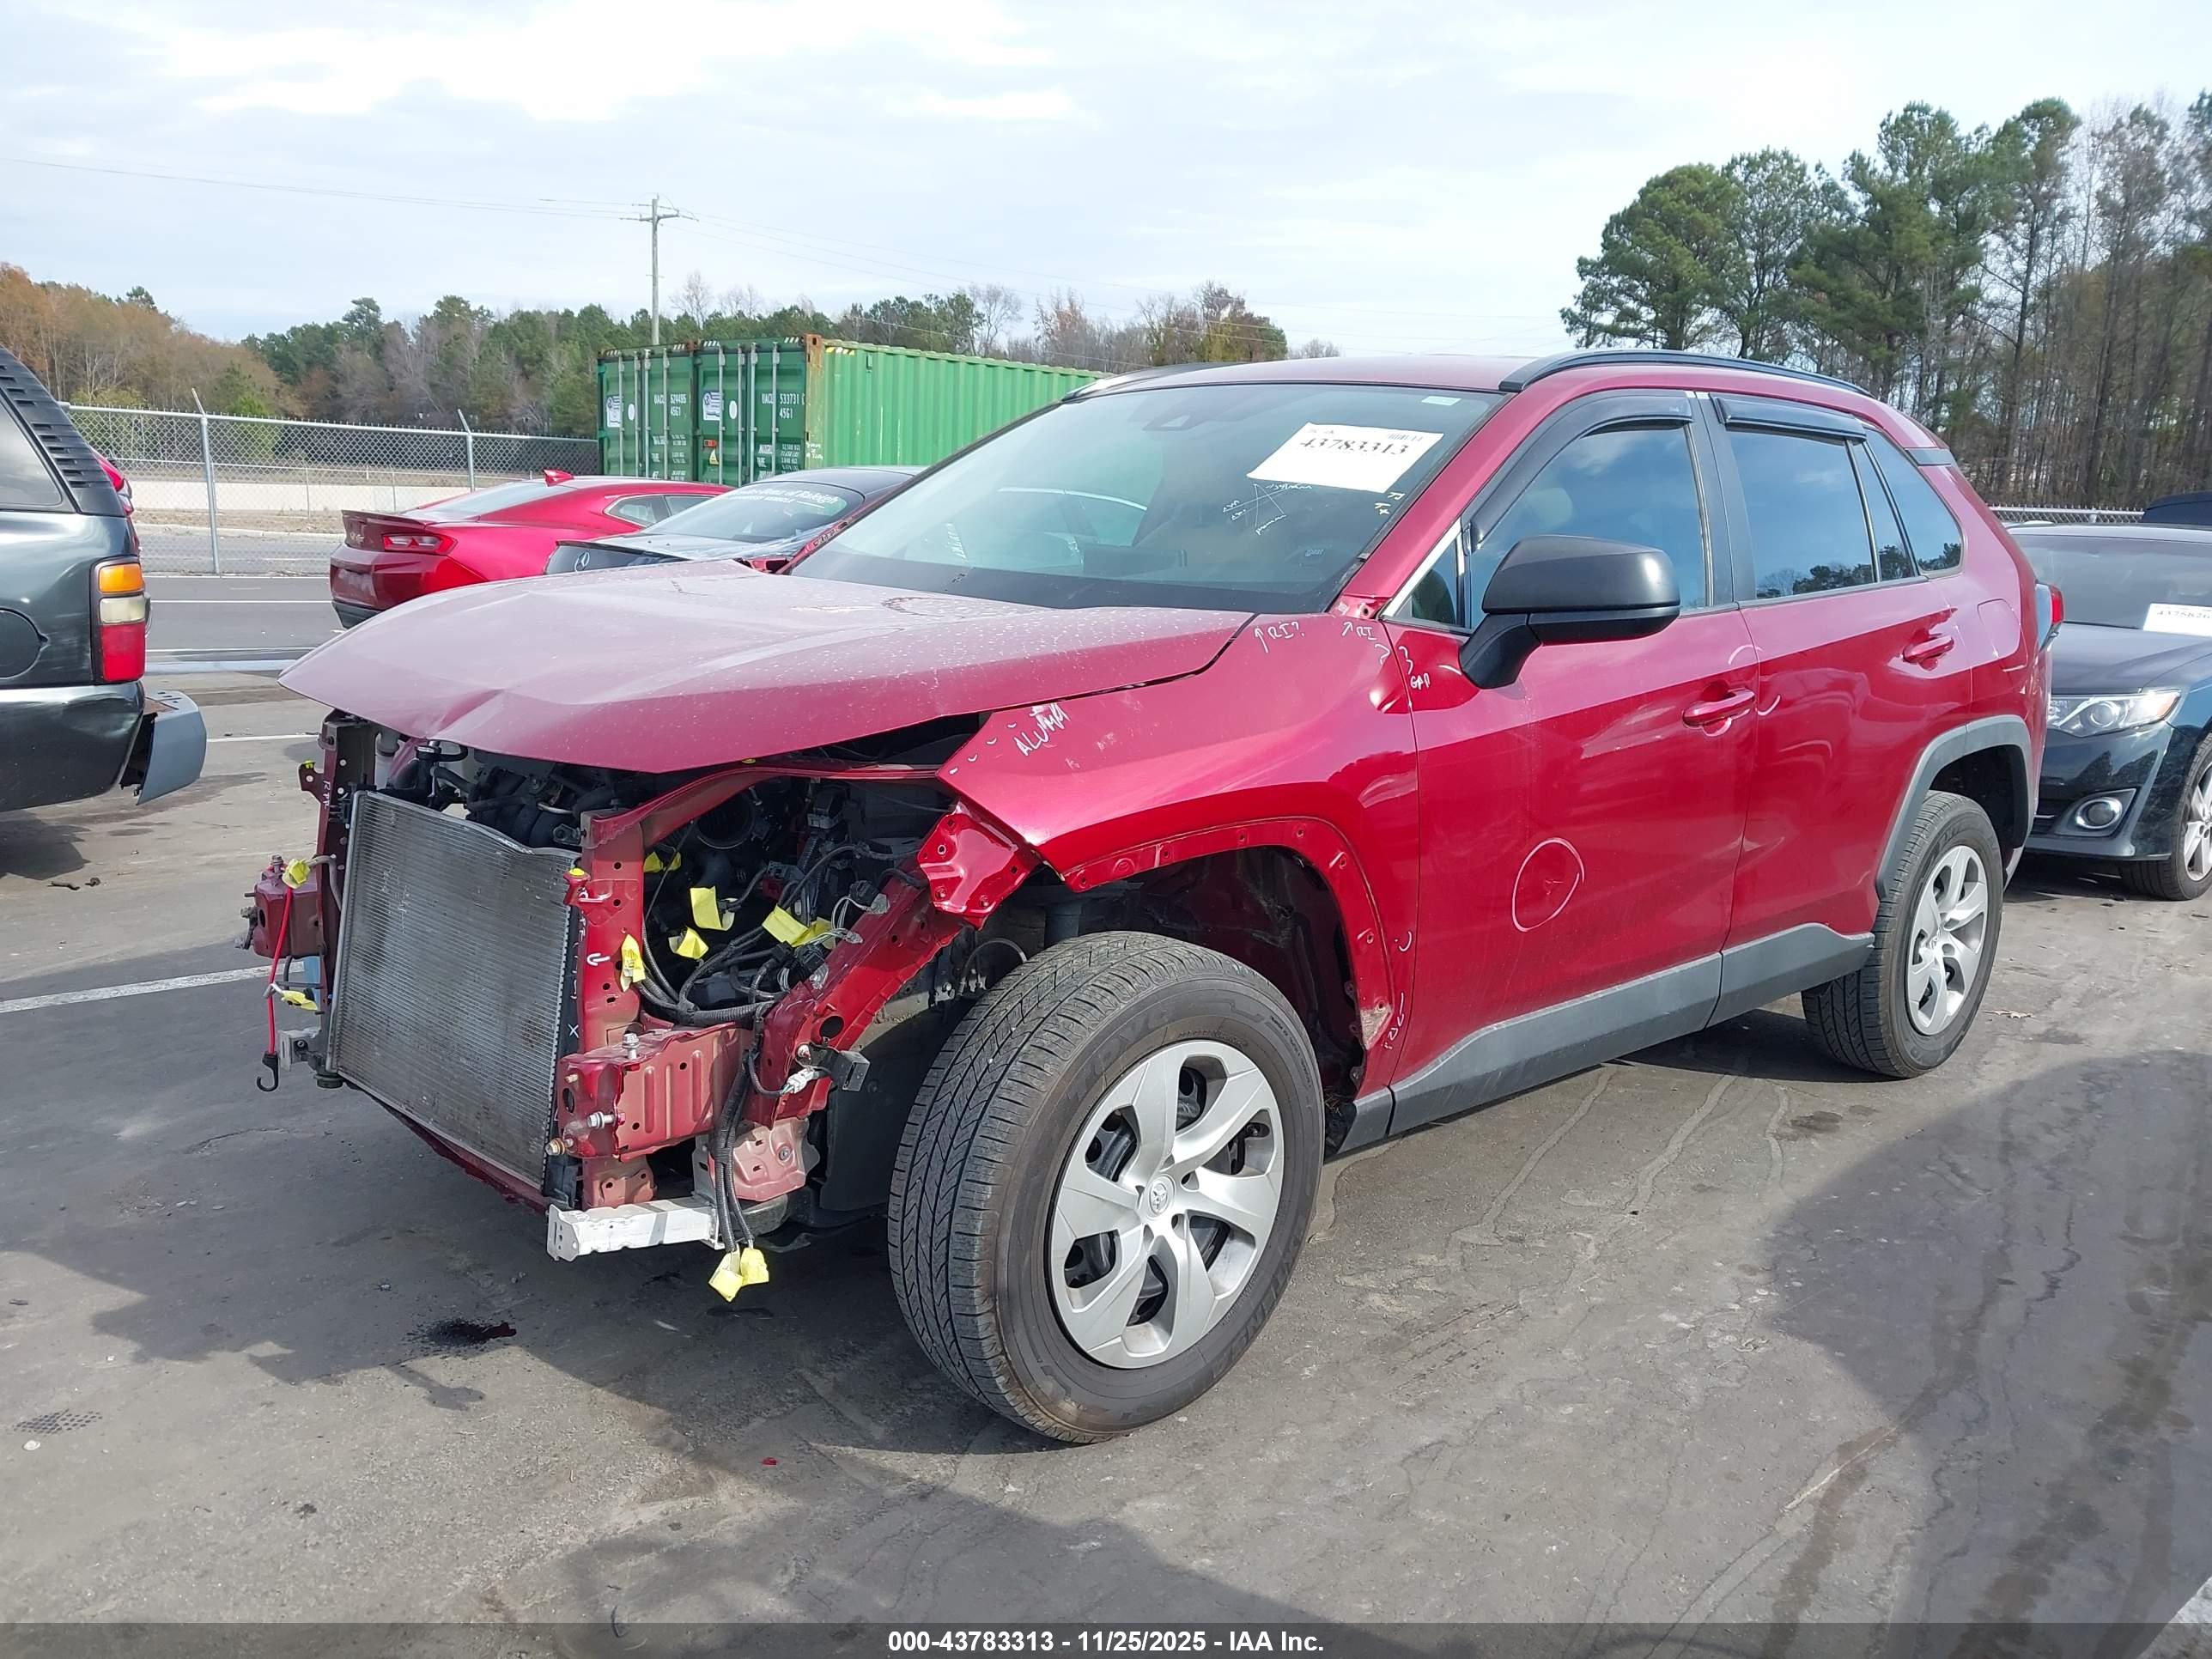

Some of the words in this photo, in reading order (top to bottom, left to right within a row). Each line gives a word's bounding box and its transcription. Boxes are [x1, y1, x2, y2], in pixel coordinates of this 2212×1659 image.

[780, 393, 800, 405] 533731
[779, 407, 793, 420] 45G1
[1300, 438, 1409, 455] 43783313
